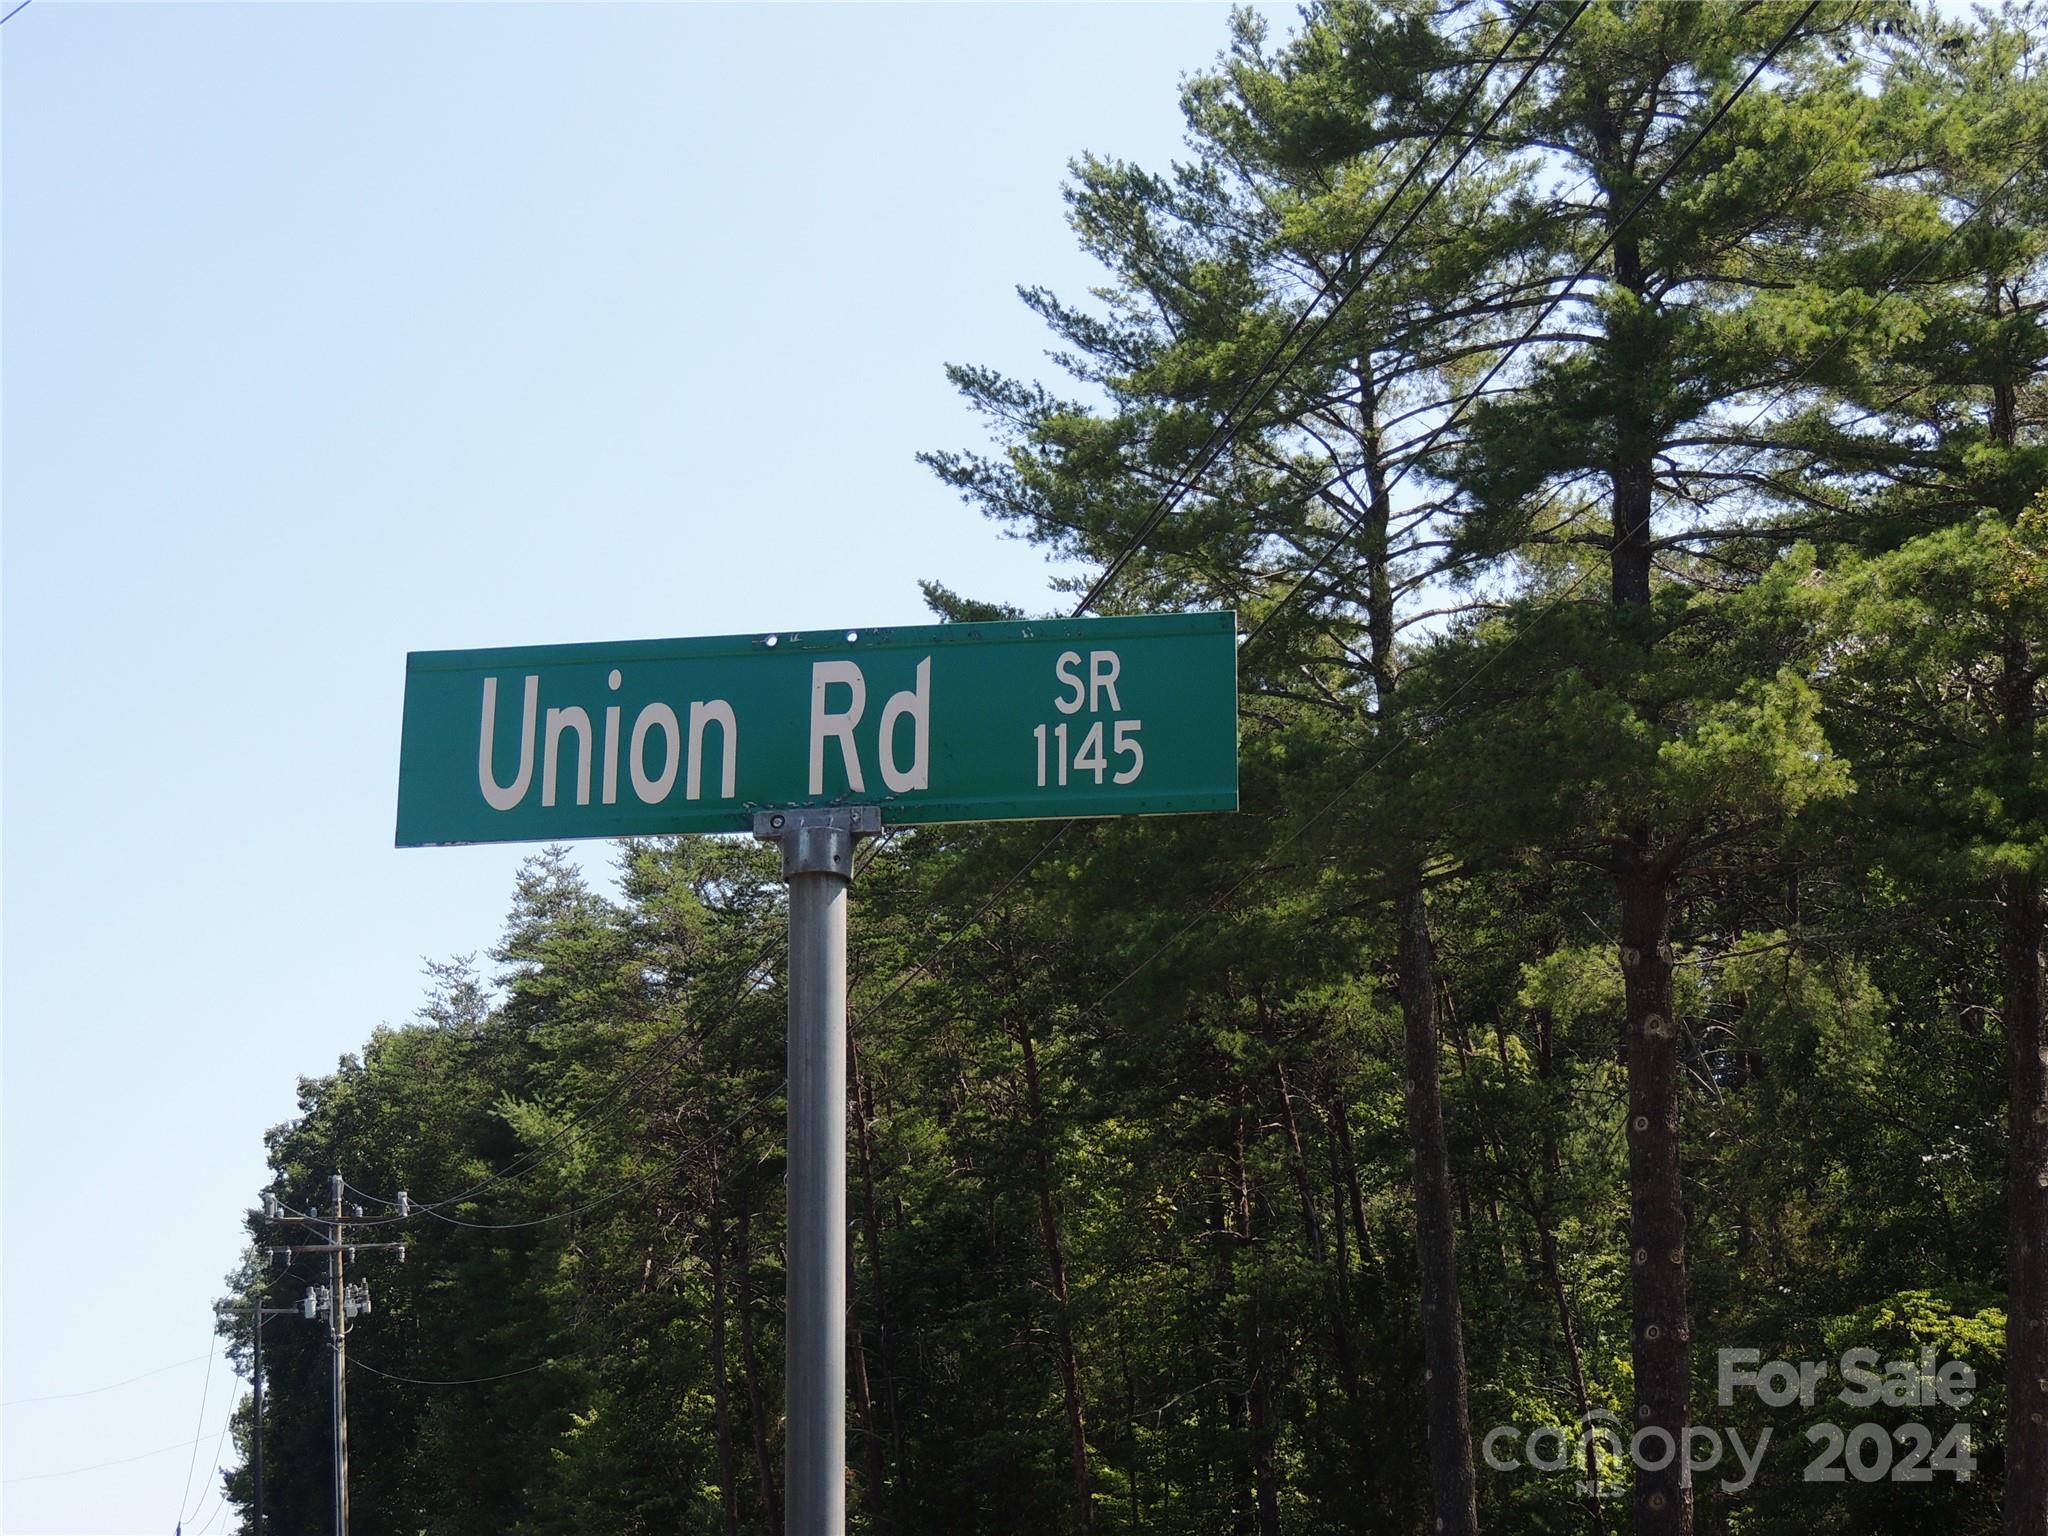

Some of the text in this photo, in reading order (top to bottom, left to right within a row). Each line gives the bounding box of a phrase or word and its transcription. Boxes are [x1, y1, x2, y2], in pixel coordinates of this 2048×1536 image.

[1054, 650, 1122, 715] SR
[479, 656, 932, 812] Union Rd
[1034, 720, 1146, 787] 1145
